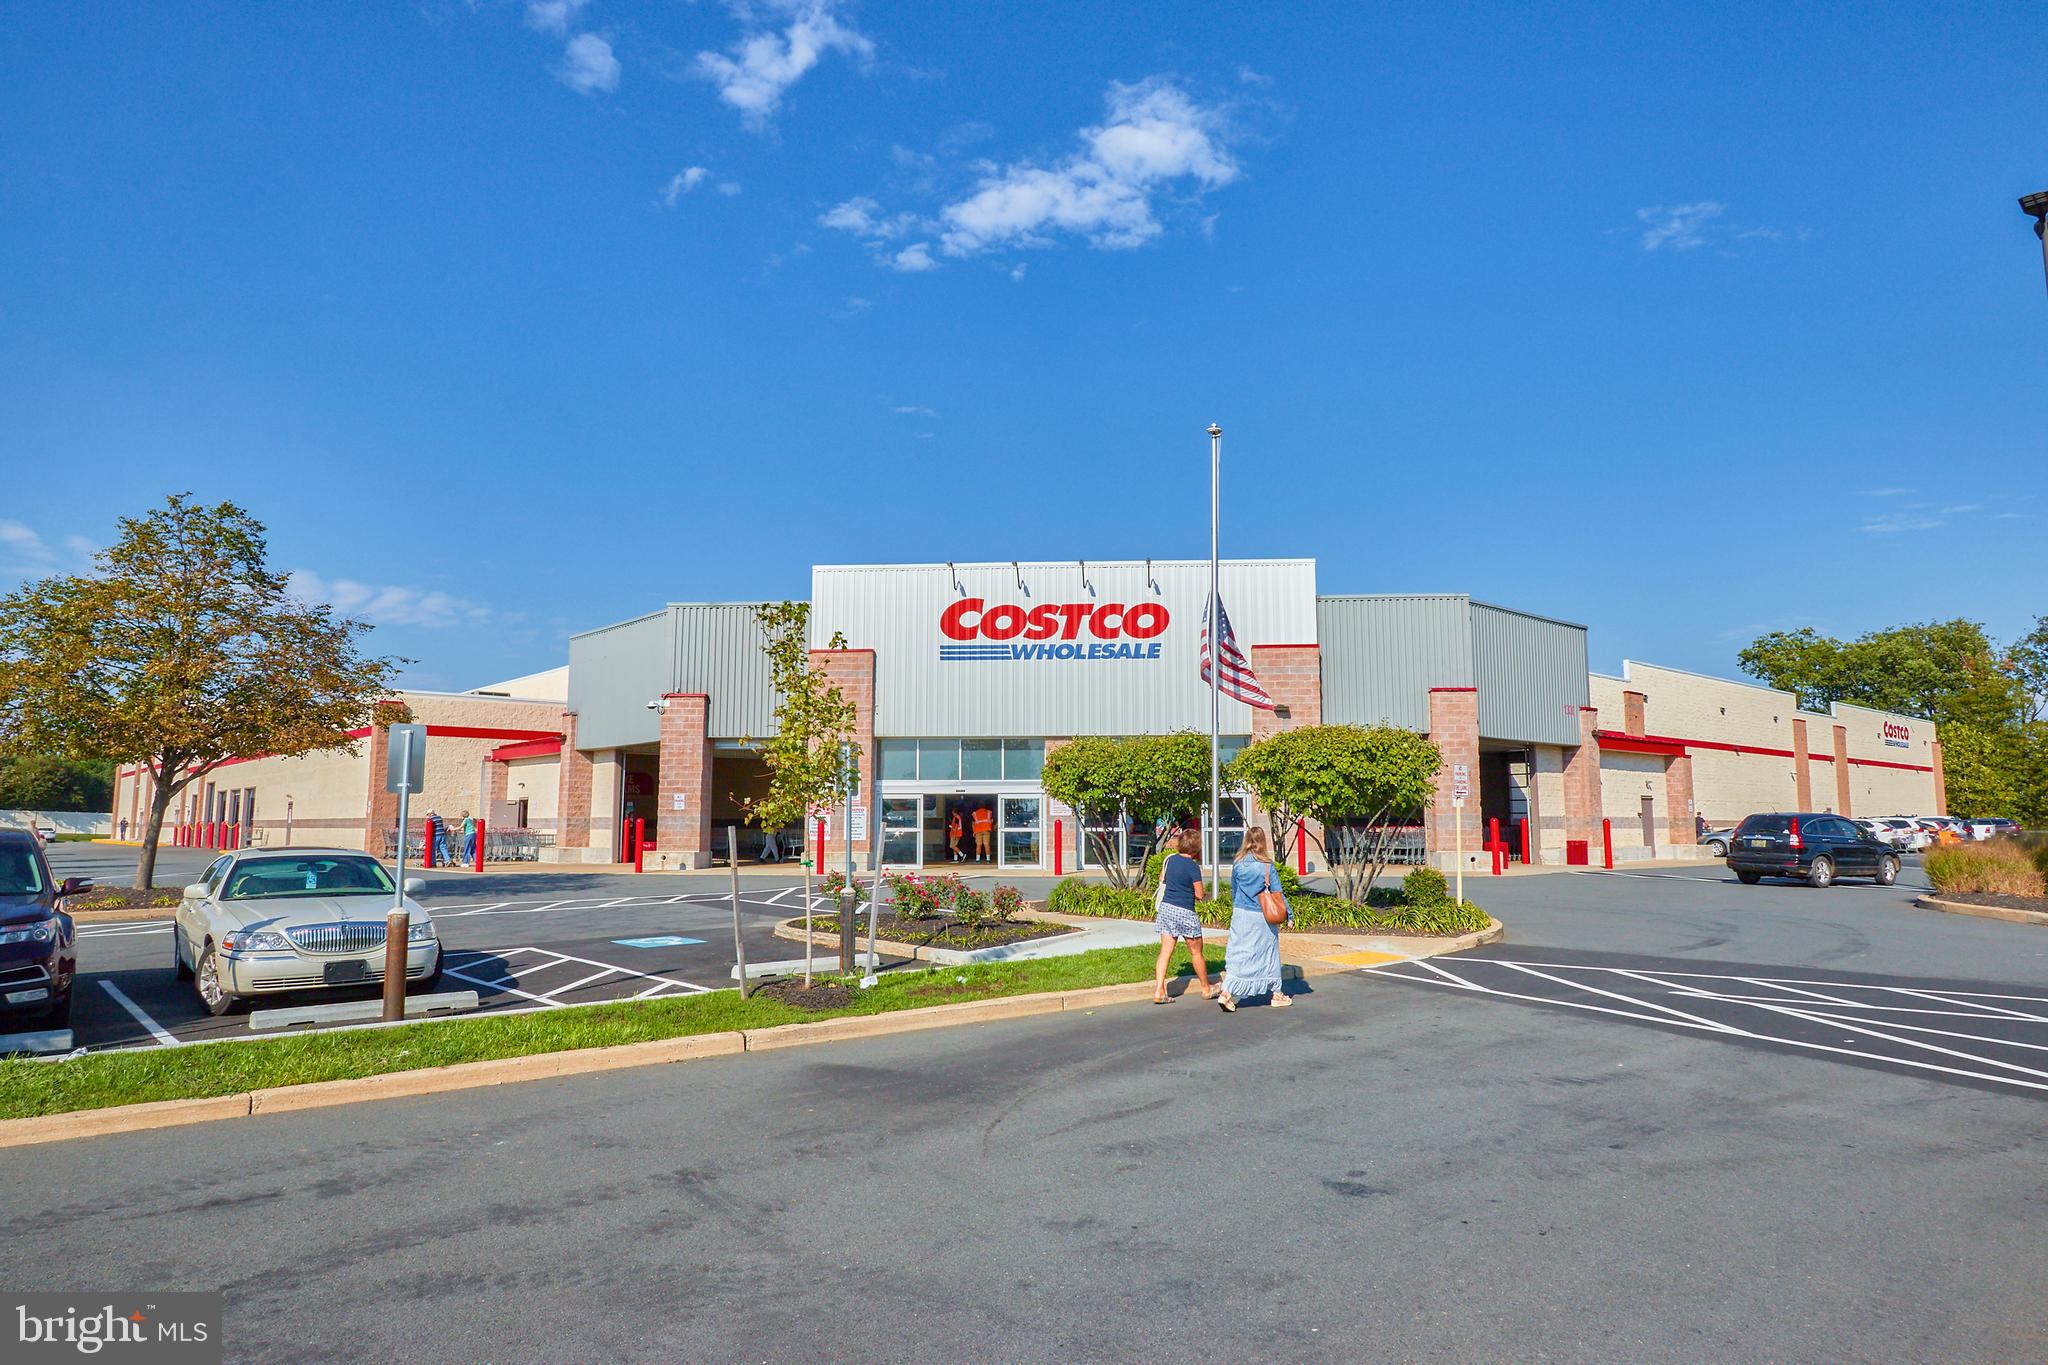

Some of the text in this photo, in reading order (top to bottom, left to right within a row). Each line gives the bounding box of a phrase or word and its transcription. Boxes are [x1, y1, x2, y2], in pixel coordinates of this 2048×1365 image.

[940, 598, 1170, 641] COSTCO
[1010, 643, 1162, 660] WHOLESALE
[1883, 720, 1909, 741] COSTCO
